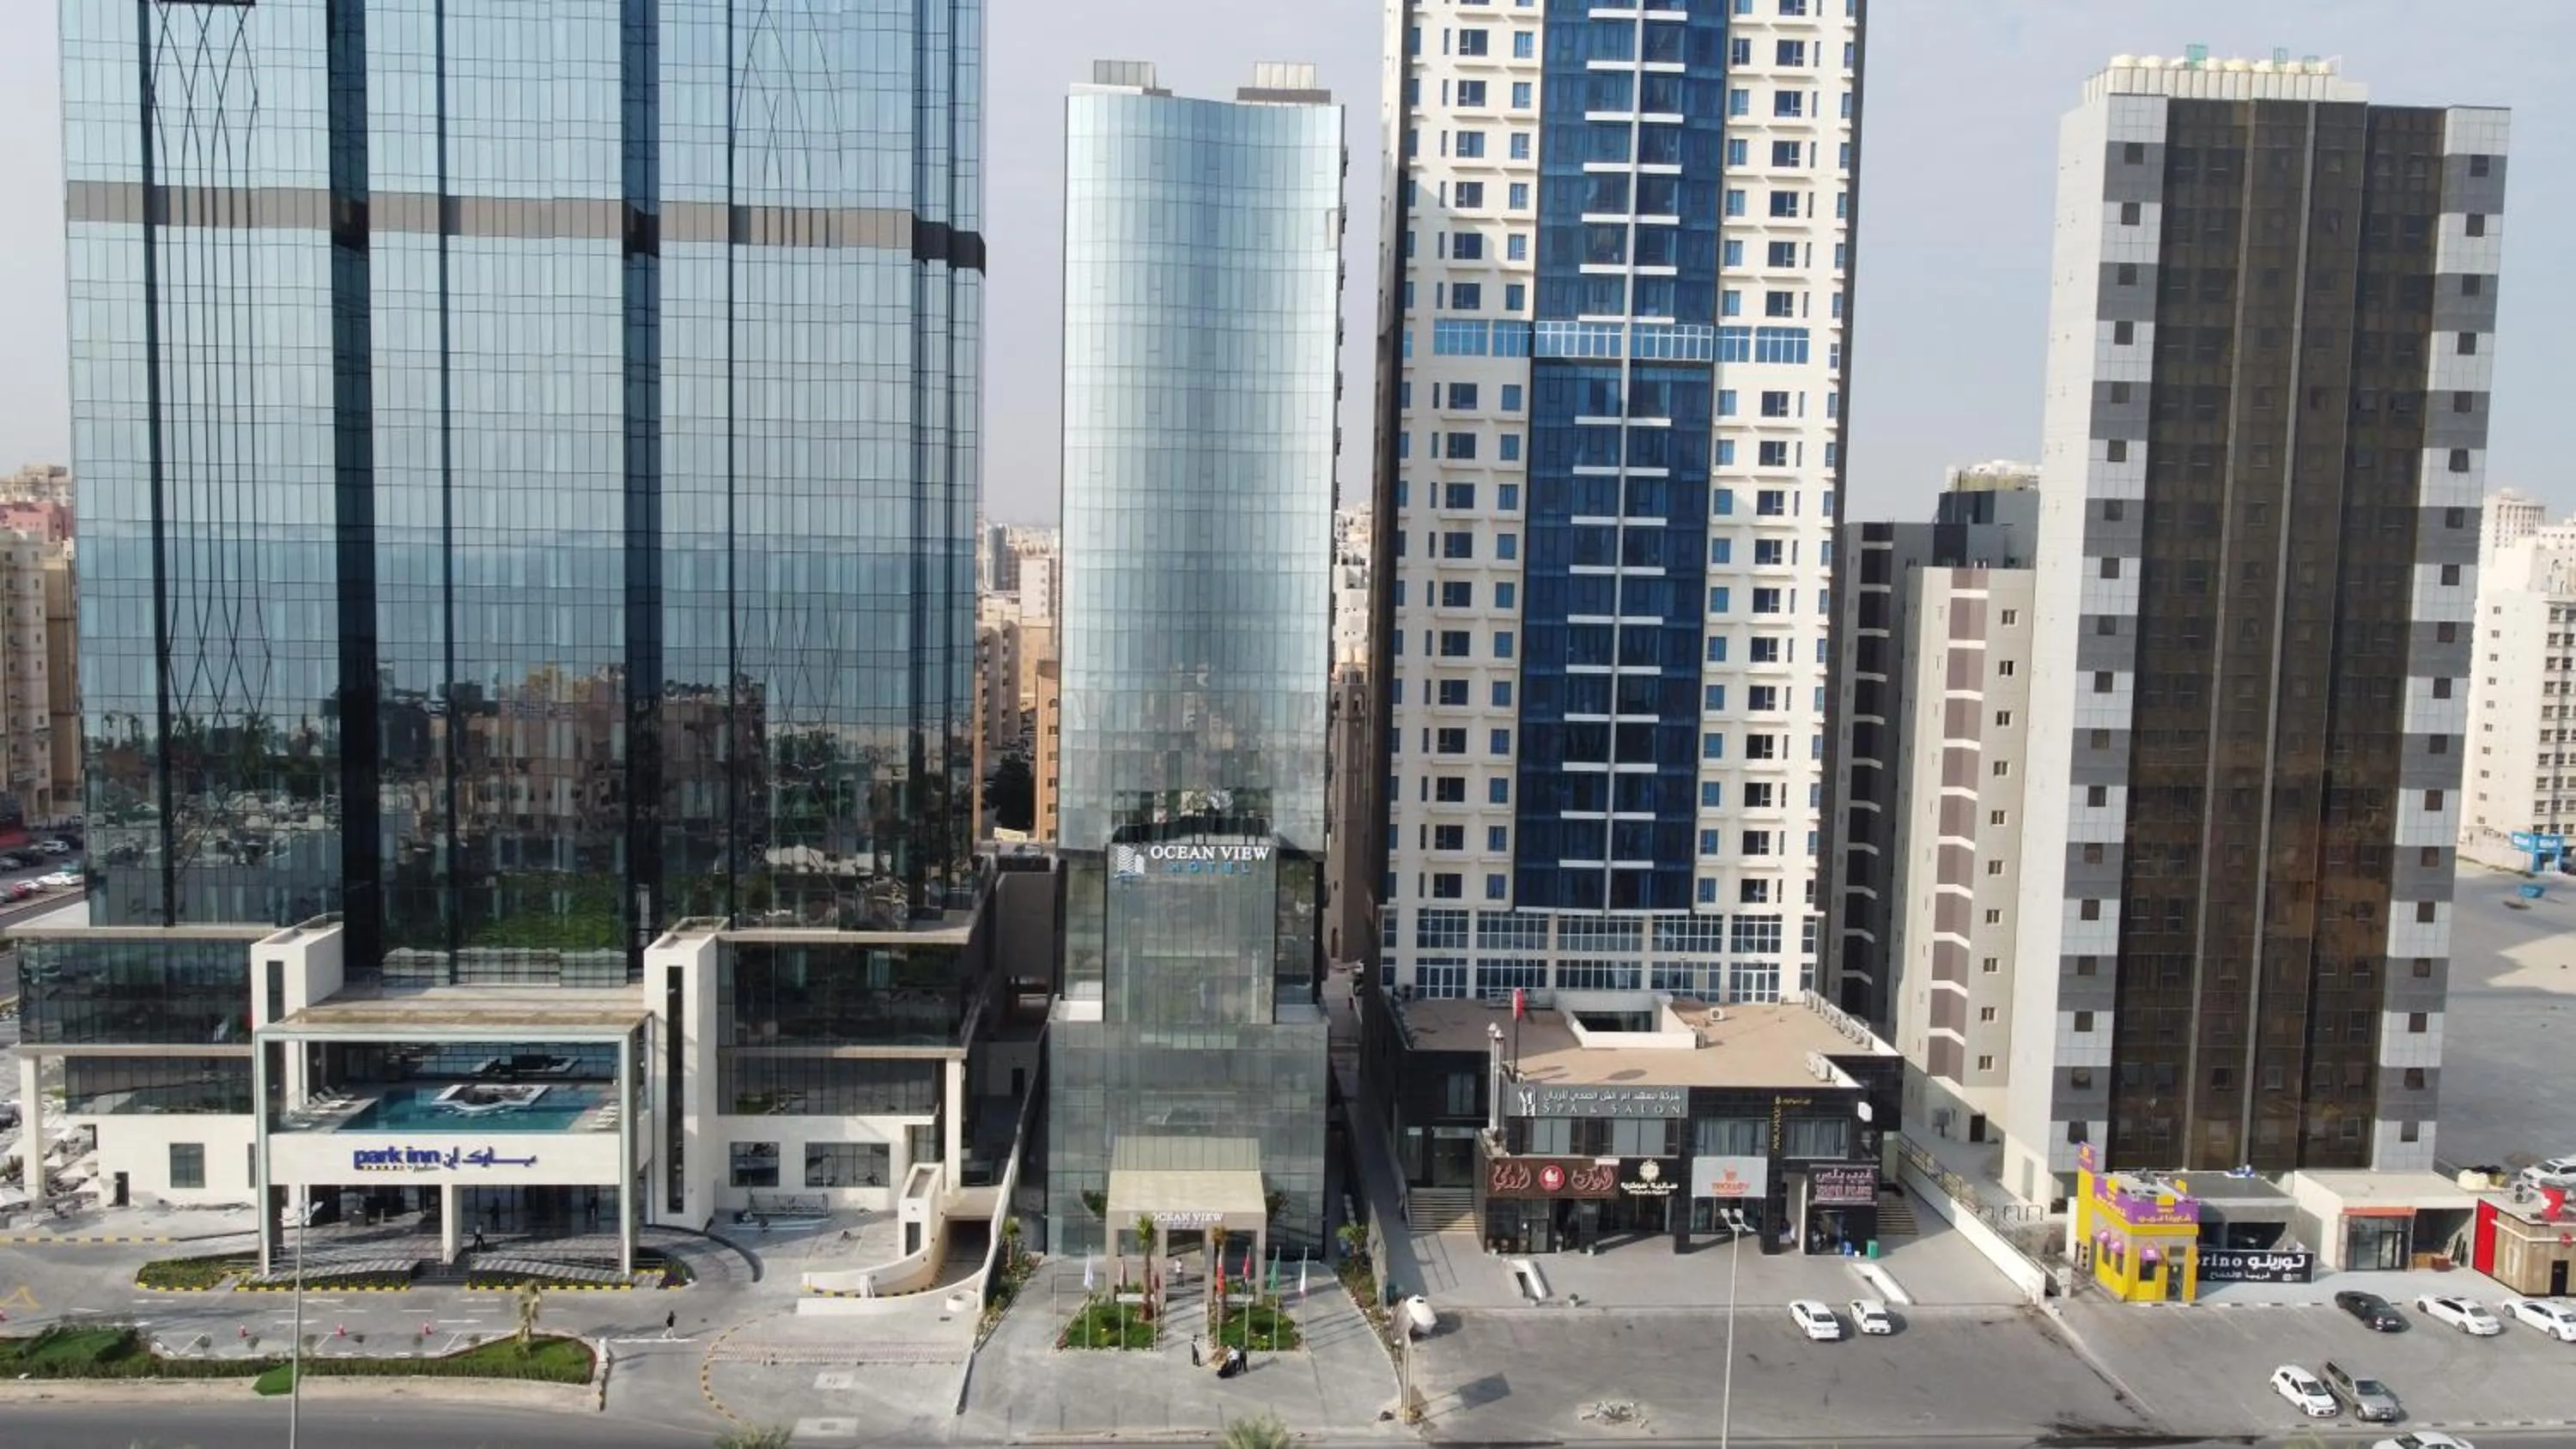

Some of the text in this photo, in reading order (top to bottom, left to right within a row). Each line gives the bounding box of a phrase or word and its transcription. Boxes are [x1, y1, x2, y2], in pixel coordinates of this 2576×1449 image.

[1151, 845, 1269, 861] OCEAN VIEW
[353, 1145, 404, 1171] park
[405, 1146, 441, 1164] inn
[1192, 1211, 1224, 1222] VIEW
[2247, 1254, 2306, 1270] تورينو
